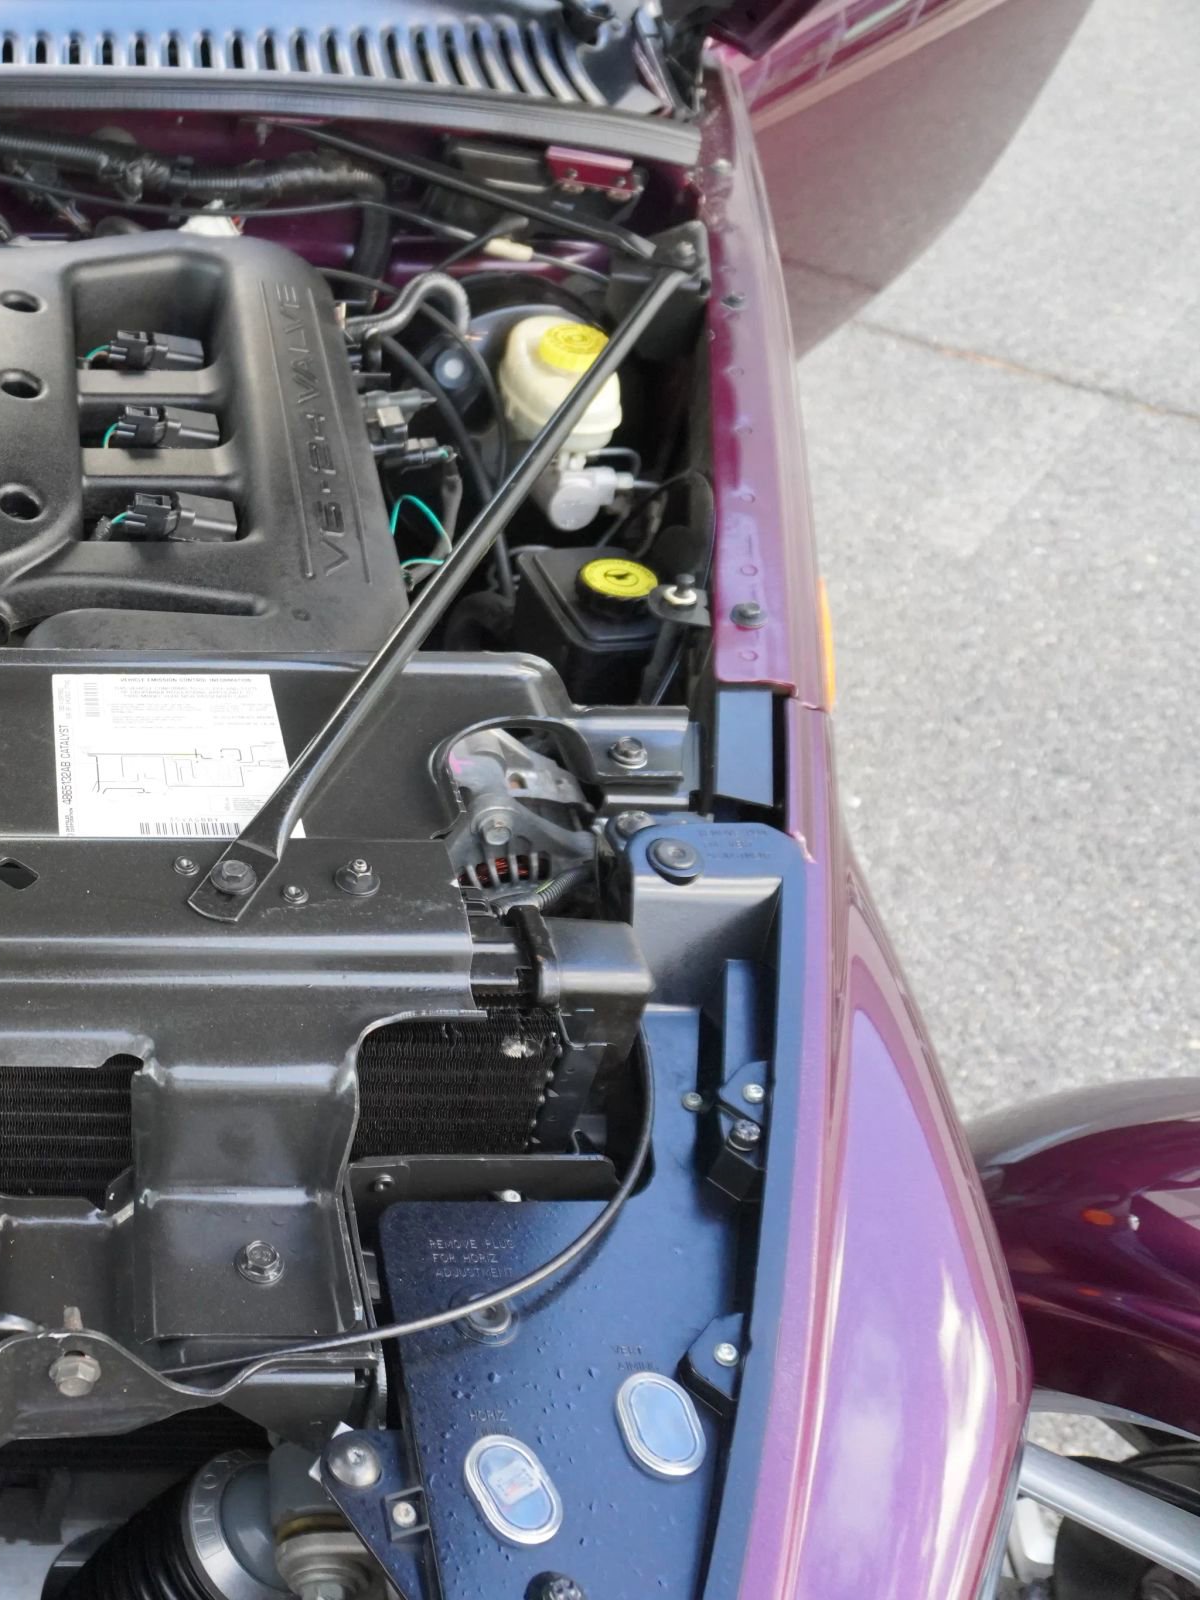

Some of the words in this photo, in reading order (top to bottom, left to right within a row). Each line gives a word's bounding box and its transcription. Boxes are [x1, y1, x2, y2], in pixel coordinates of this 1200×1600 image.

[58, 724, 71, 760] CATALYST
[428, 1239, 478, 1249] REMOVE
[463, 1253, 499, 1263] HORIZ
